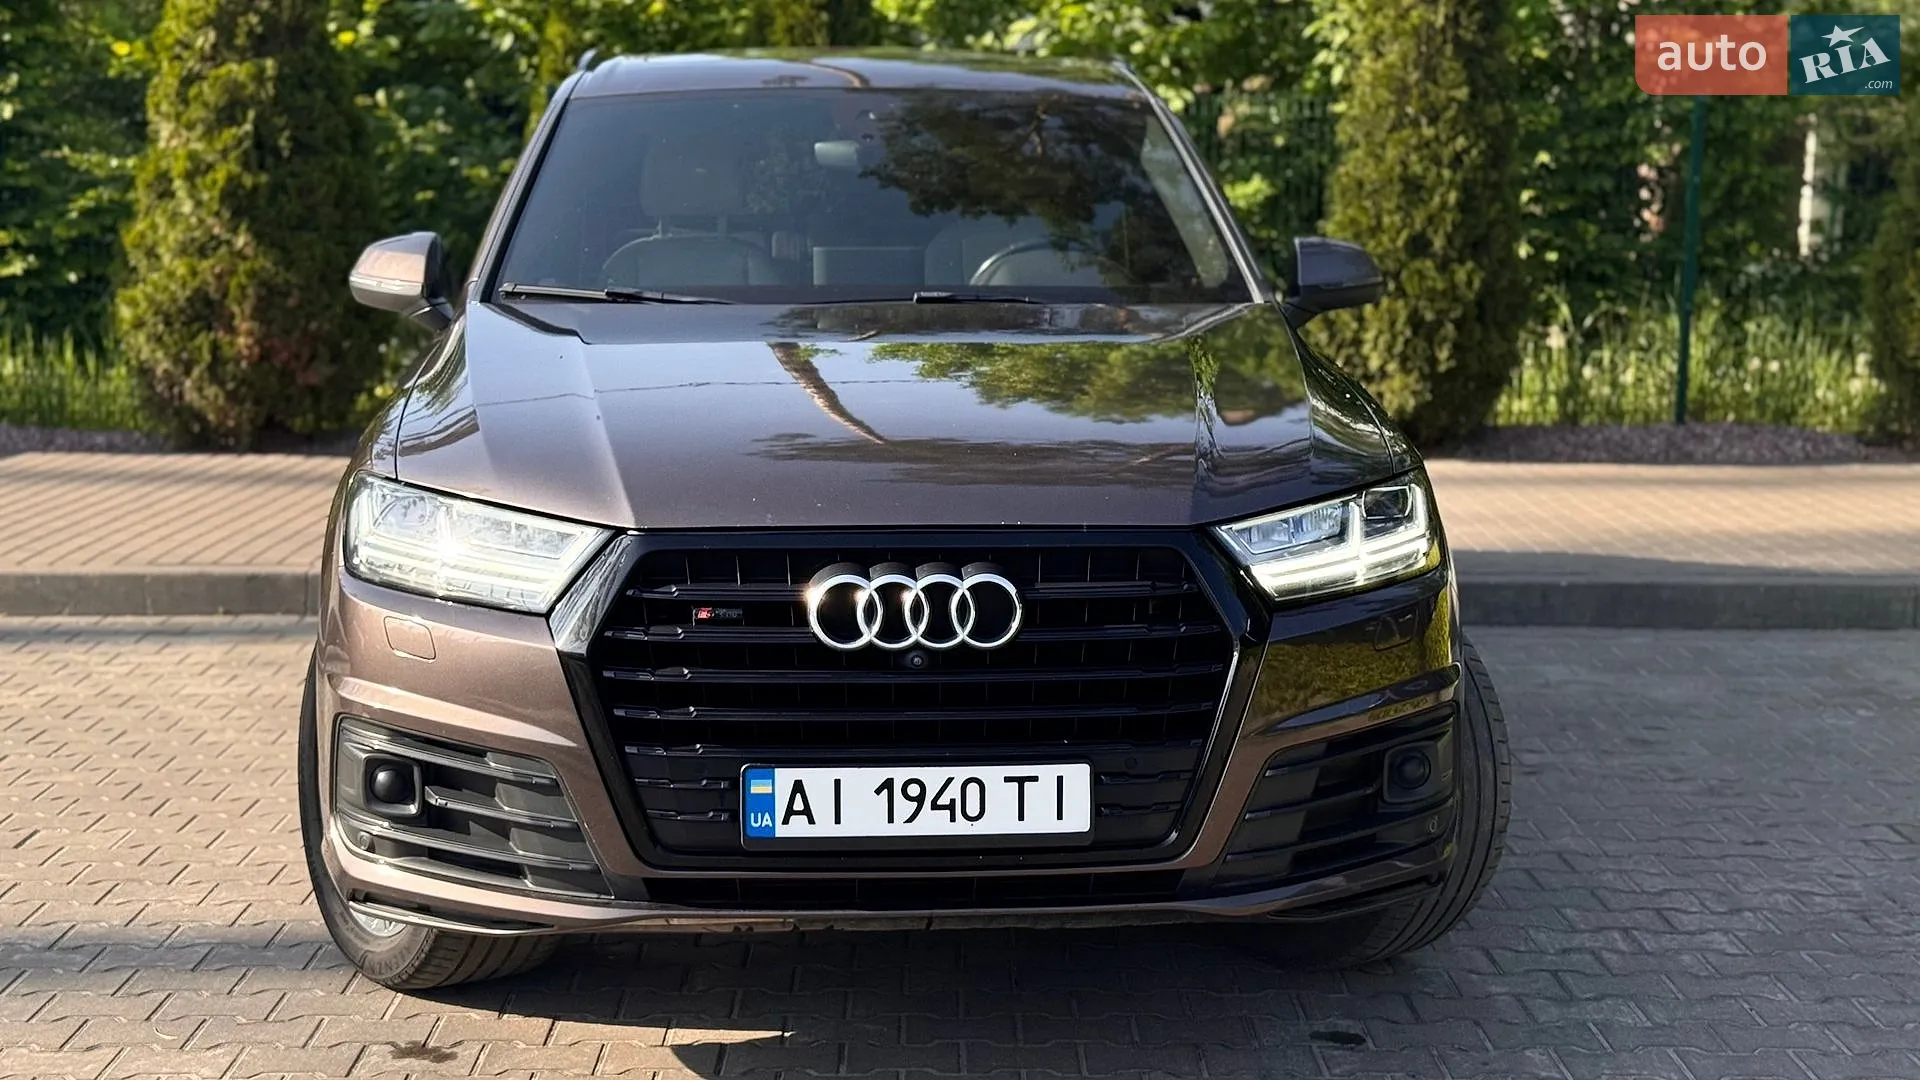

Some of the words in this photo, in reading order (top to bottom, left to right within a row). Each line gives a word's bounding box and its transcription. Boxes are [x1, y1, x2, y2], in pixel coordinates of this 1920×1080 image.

[781, 778, 842, 826] AI
[873, 776, 986, 824] 1940
[1003, 775, 1064, 822] TI
[750, 812, 773, 828] UA
